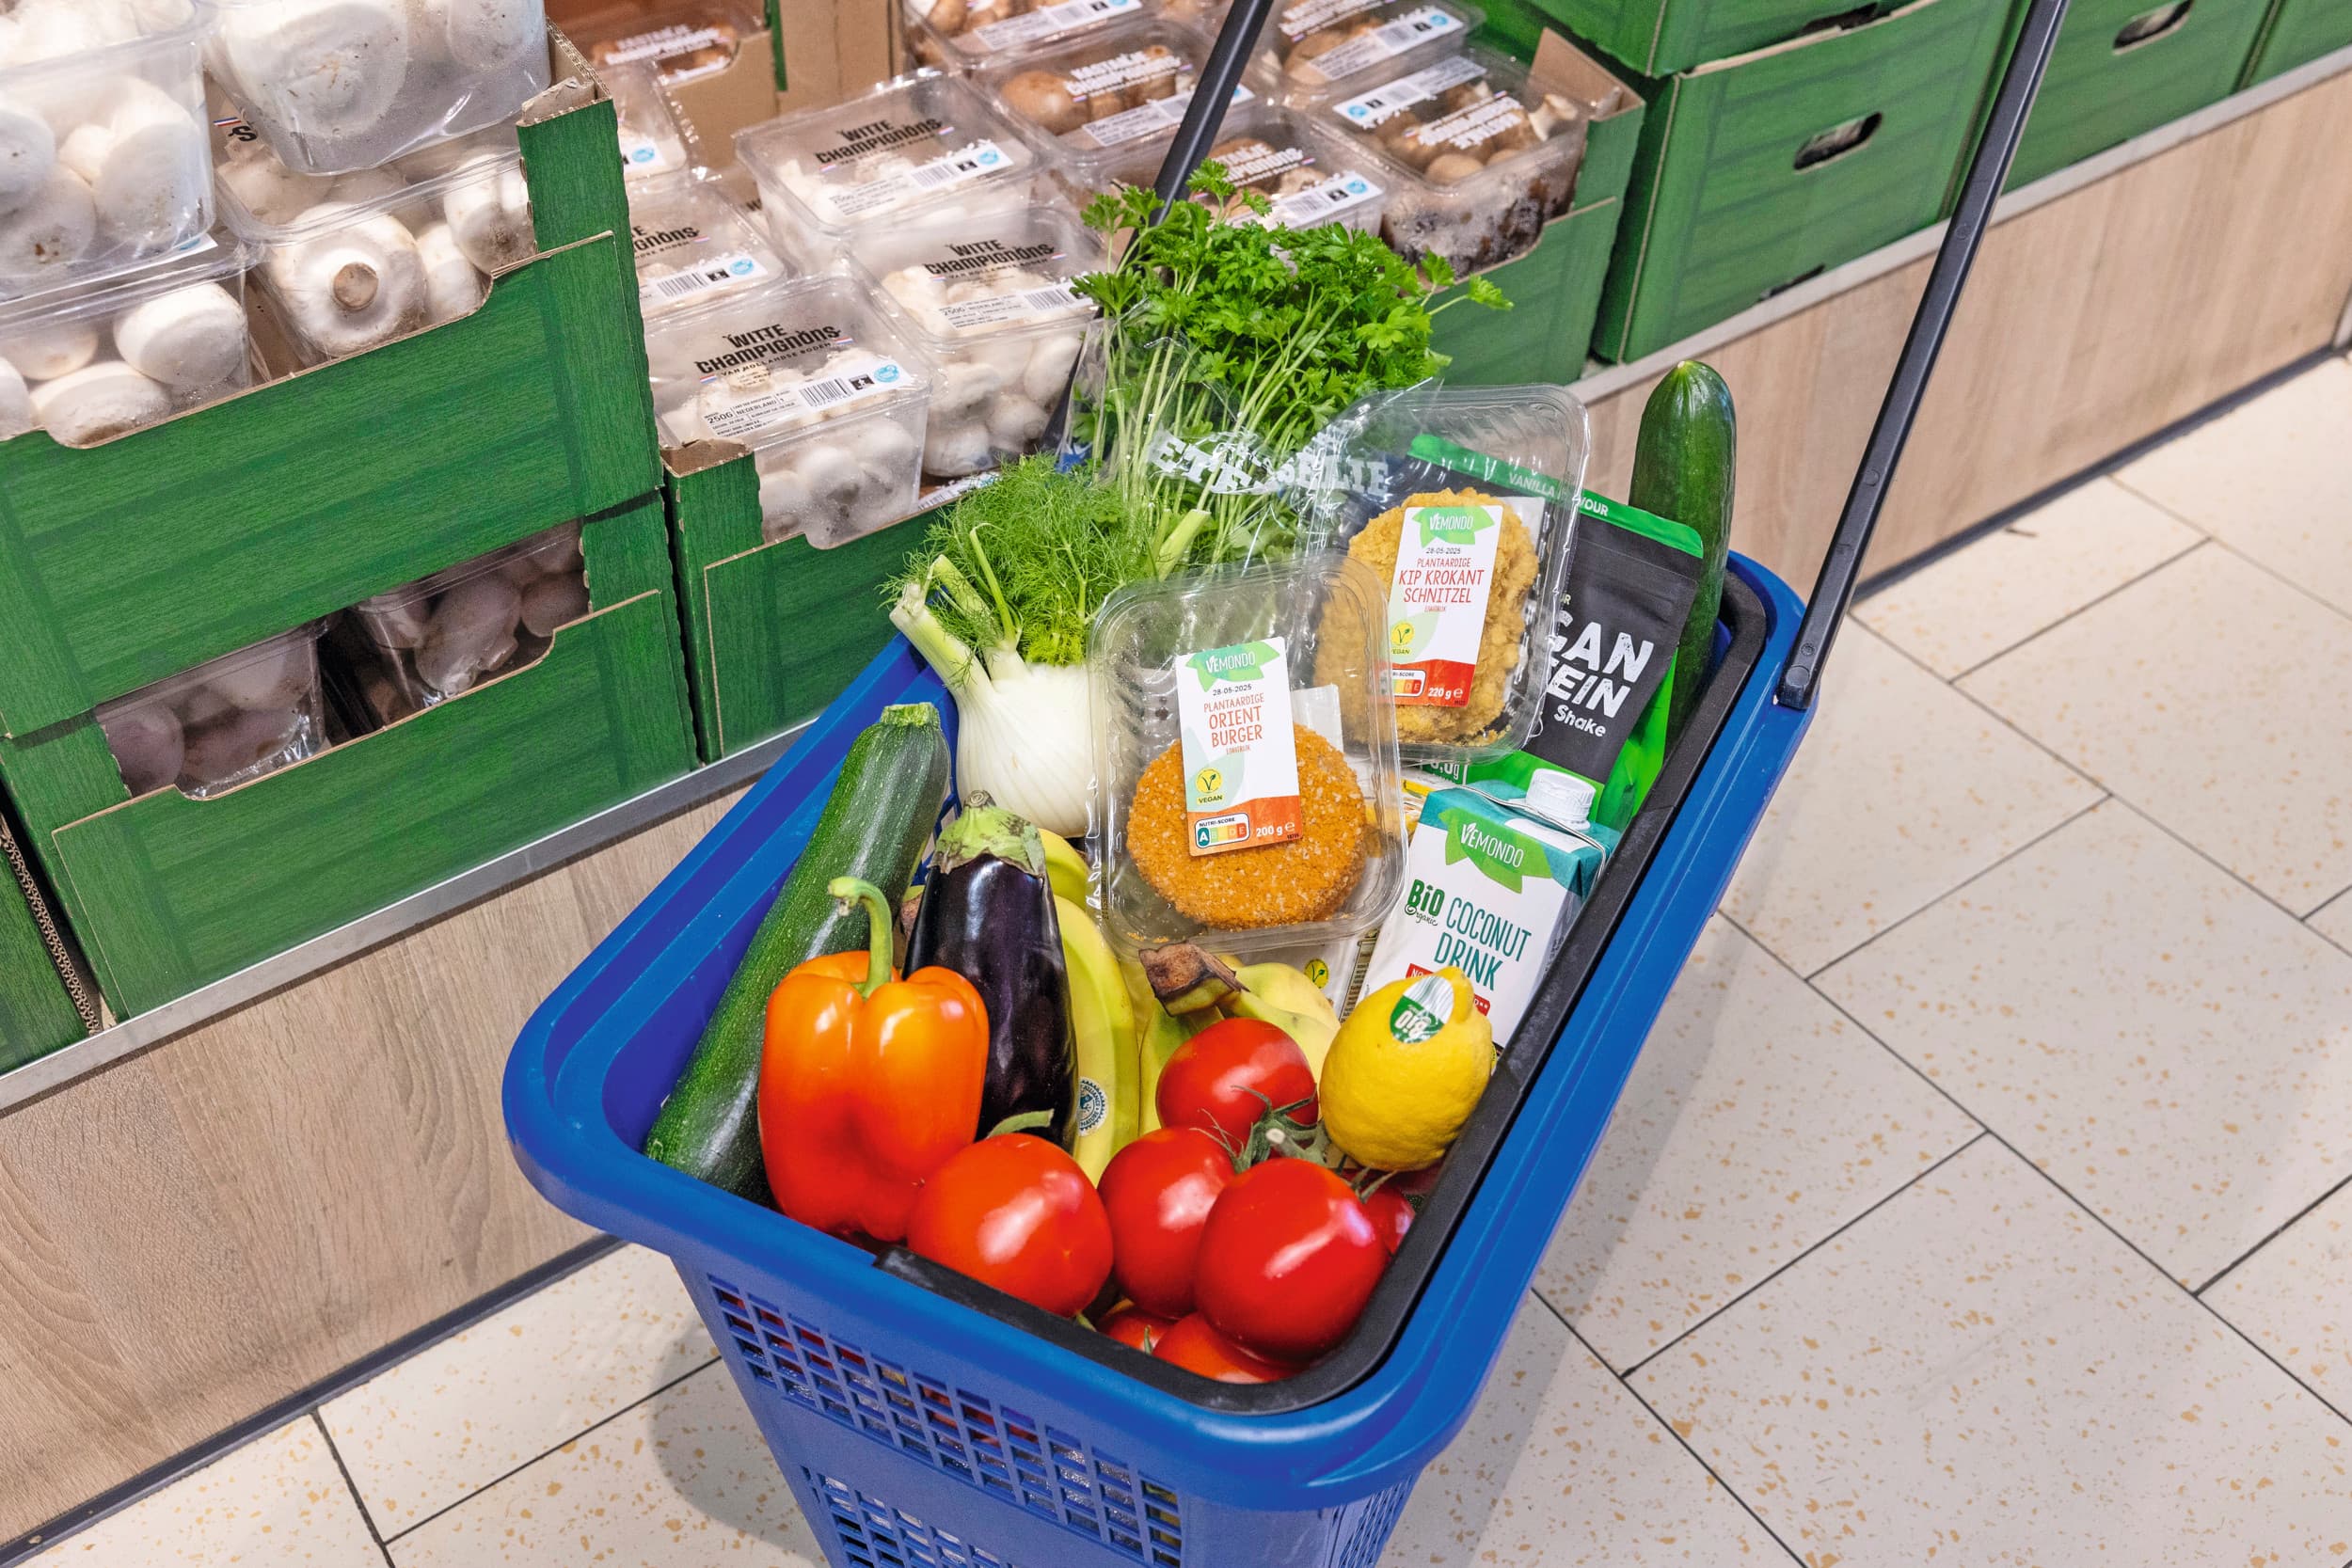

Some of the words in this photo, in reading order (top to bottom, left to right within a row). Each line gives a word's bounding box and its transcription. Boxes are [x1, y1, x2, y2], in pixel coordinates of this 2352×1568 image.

[837, 119, 895, 142] WITTE
[946, 239, 1006, 258] WITTE
[723, 324, 787, 348] WITTE
[722, 368, 740, 377] VAN
[800, 342, 833, 355] BODEM
[707, 412, 734, 424] 250G
[737, 400, 778, 416] NEDERLAND
[1509, 472, 1555, 498] VANILLA
[1417, 557, 1472, 568] PLANTAARDIGE
[1399, 570, 1422, 585] KIP
[1425, 569, 1485, 585] KROKANT
[1404, 588, 1472, 603] SCHNITZEL
[1428, 687, 1445, 697] 220
[1547, 660, 1631, 719] EIN
[1203, 693, 1264, 713] PLANTAARDIGE
[1208, 706, 1263, 730] ORIENT
[1553, 705, 1607, 737] Shake
[1211, 725, 1263, 749] BURGER
[1199, 795, 1223, 804] VEGAN
[1199, 817, 1236, 828] NUTRI-SCORE
[1256, 825, 1275, 837] 200
[1446, 896, 1533, 963] COCONUT
[1433, 932, 1503, 991] DRINK
